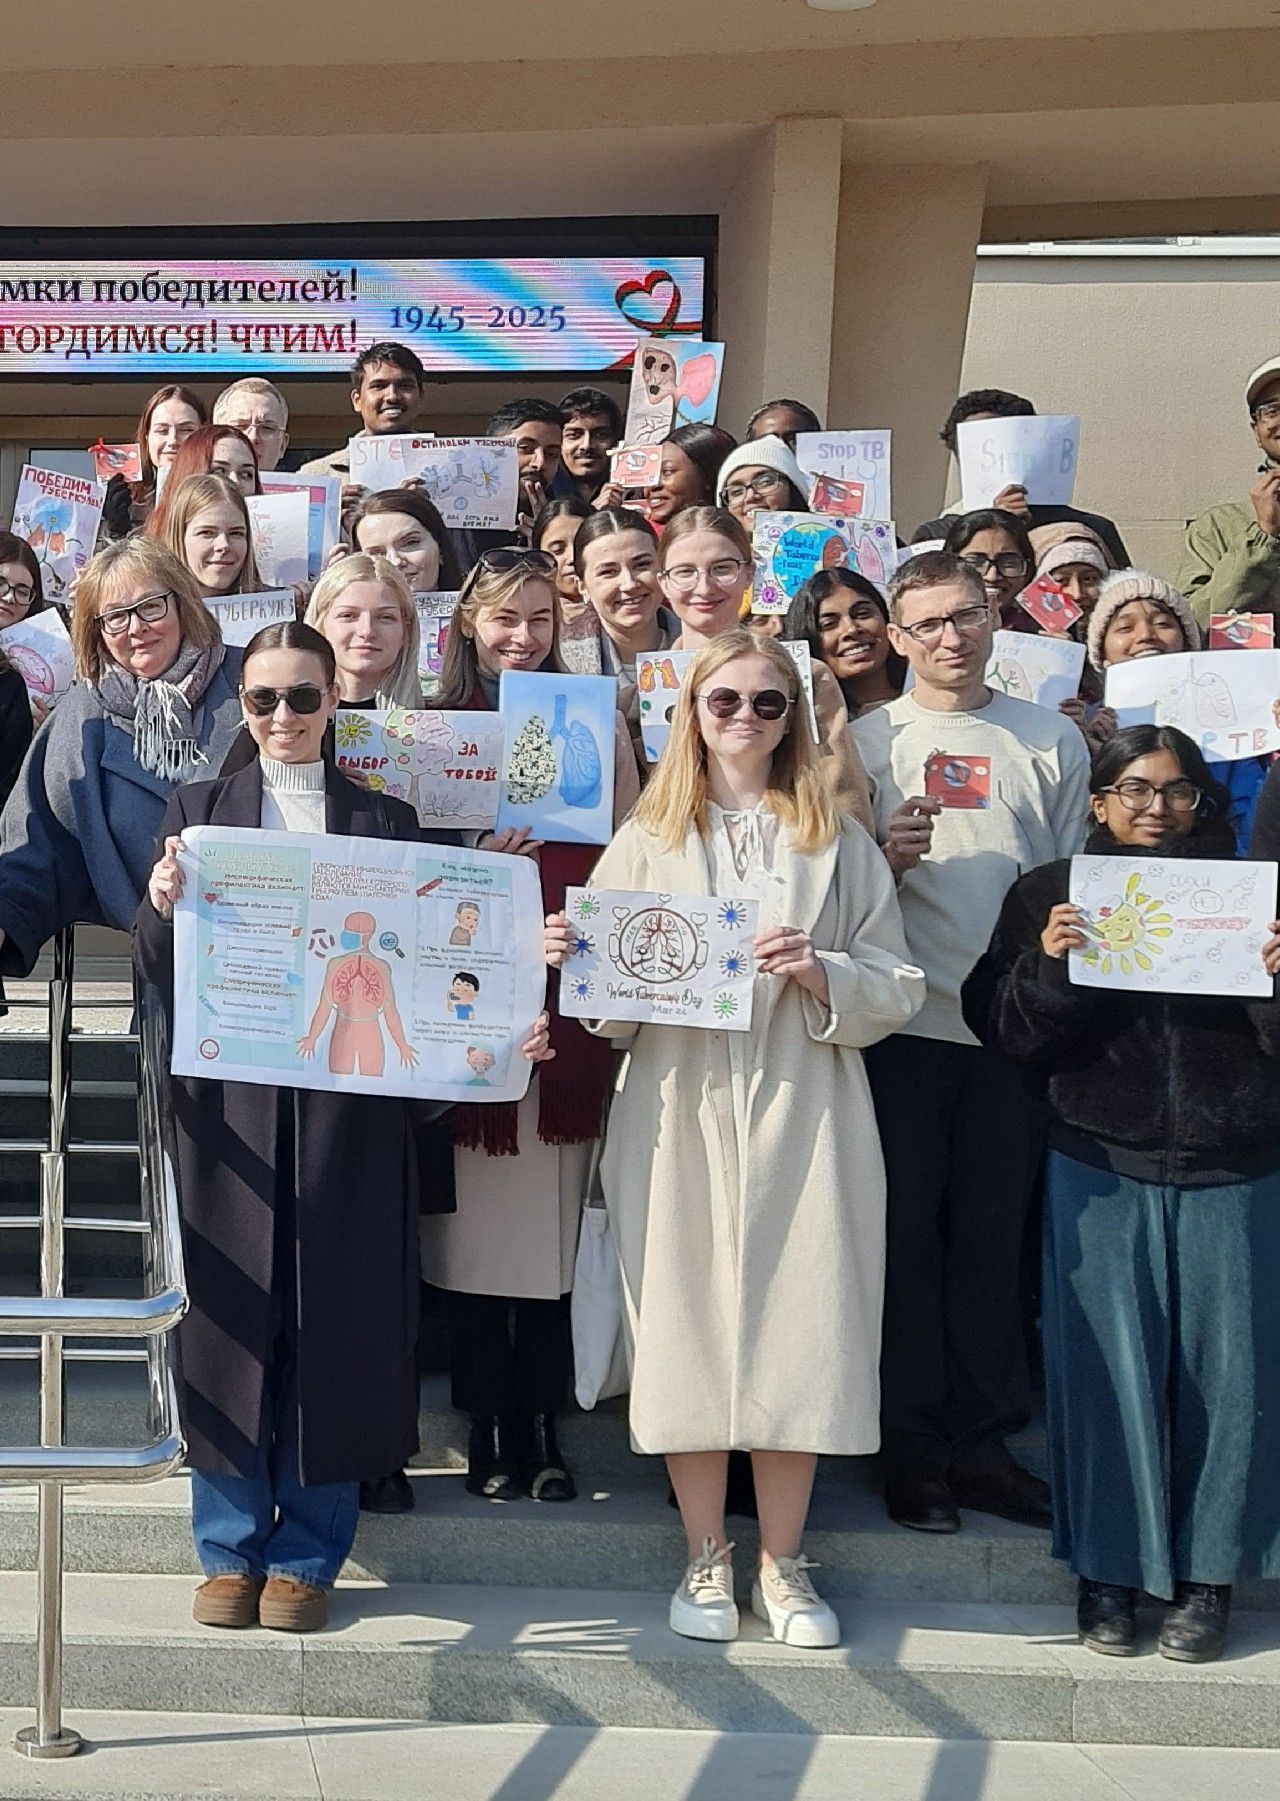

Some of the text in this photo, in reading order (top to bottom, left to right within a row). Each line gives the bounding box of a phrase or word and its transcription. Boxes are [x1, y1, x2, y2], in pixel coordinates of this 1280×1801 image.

[94, 268, 358, 308] победителей!
[229, 319, 358, 354] ЧТИМ!
[860, 440, 885, 460] TB
[24, 467, 91, 495] ПОБЕДИМ
[418, 605, 454, 617] ТУБЕР
[457, 741, 479, 756] ЗА
[338, 755, 389, 769] ВЫБОР
[444, 766, 498, 781] ТОБОЙ
